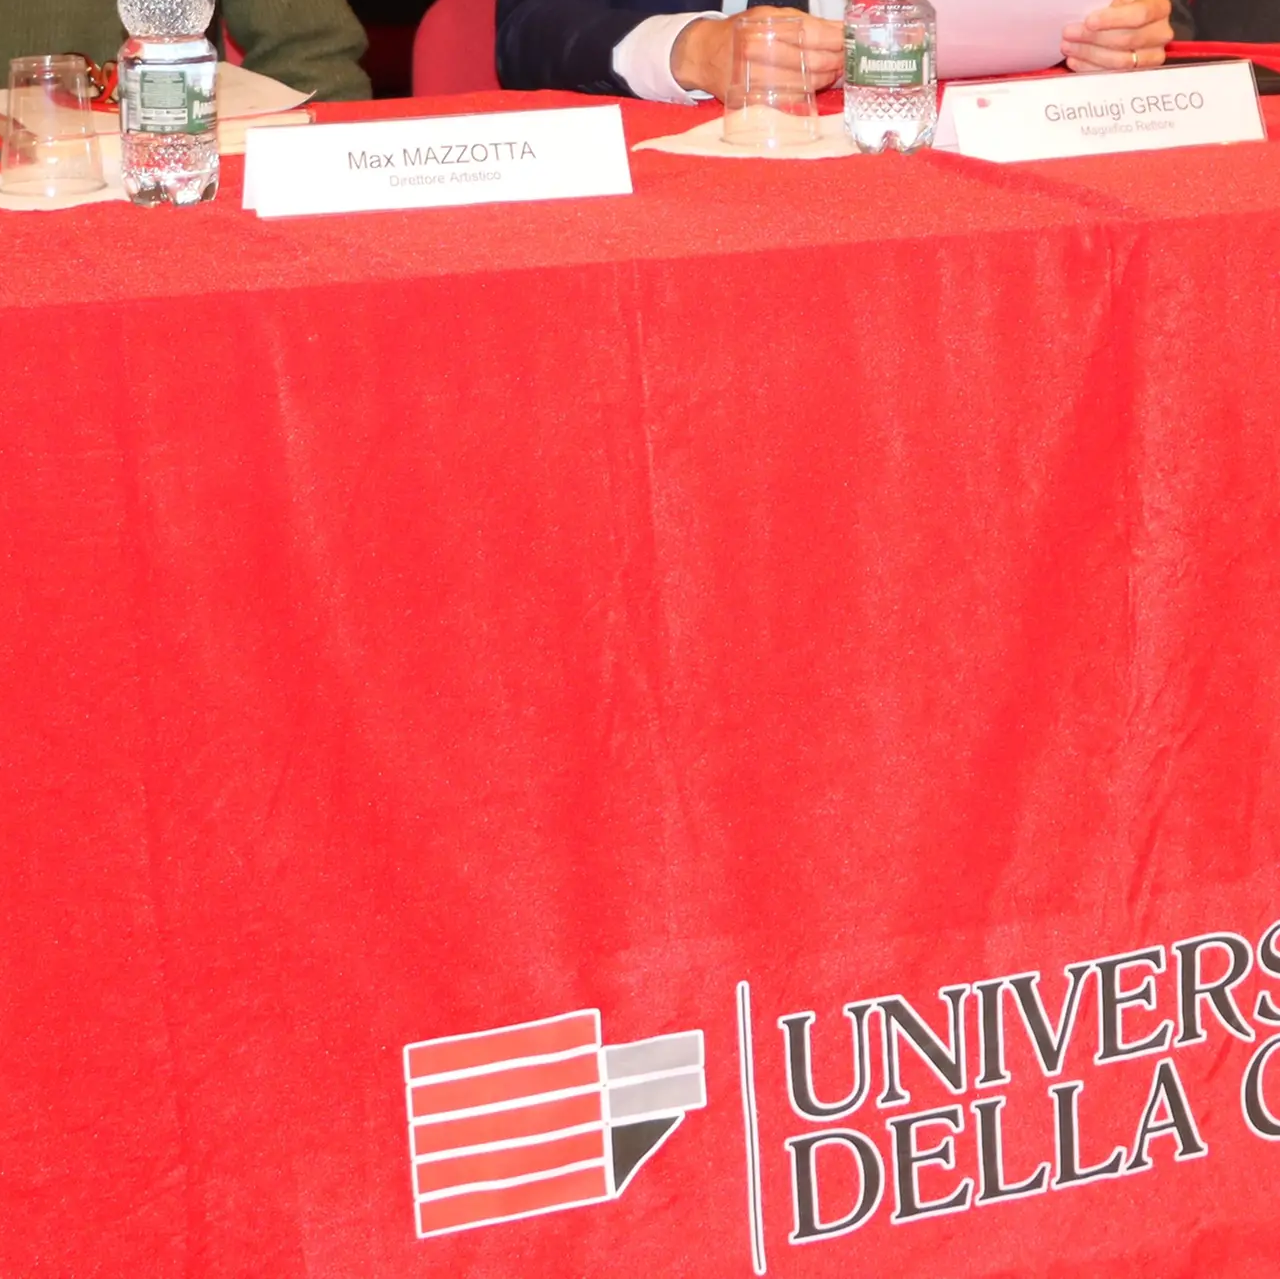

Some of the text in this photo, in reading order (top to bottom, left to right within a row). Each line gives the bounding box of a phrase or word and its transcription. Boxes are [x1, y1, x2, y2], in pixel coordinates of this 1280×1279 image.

[1044, 91, 1204, 121] Gianluigi GRECO
[1080, 119, 1175, 137] Magnifico Rettore
[347, 141, 536, 170] Max MAZZOTTA
[389, 170, 502, 187] Direttore Artistico
[785, 1056, 1208, 1247] DELLA
